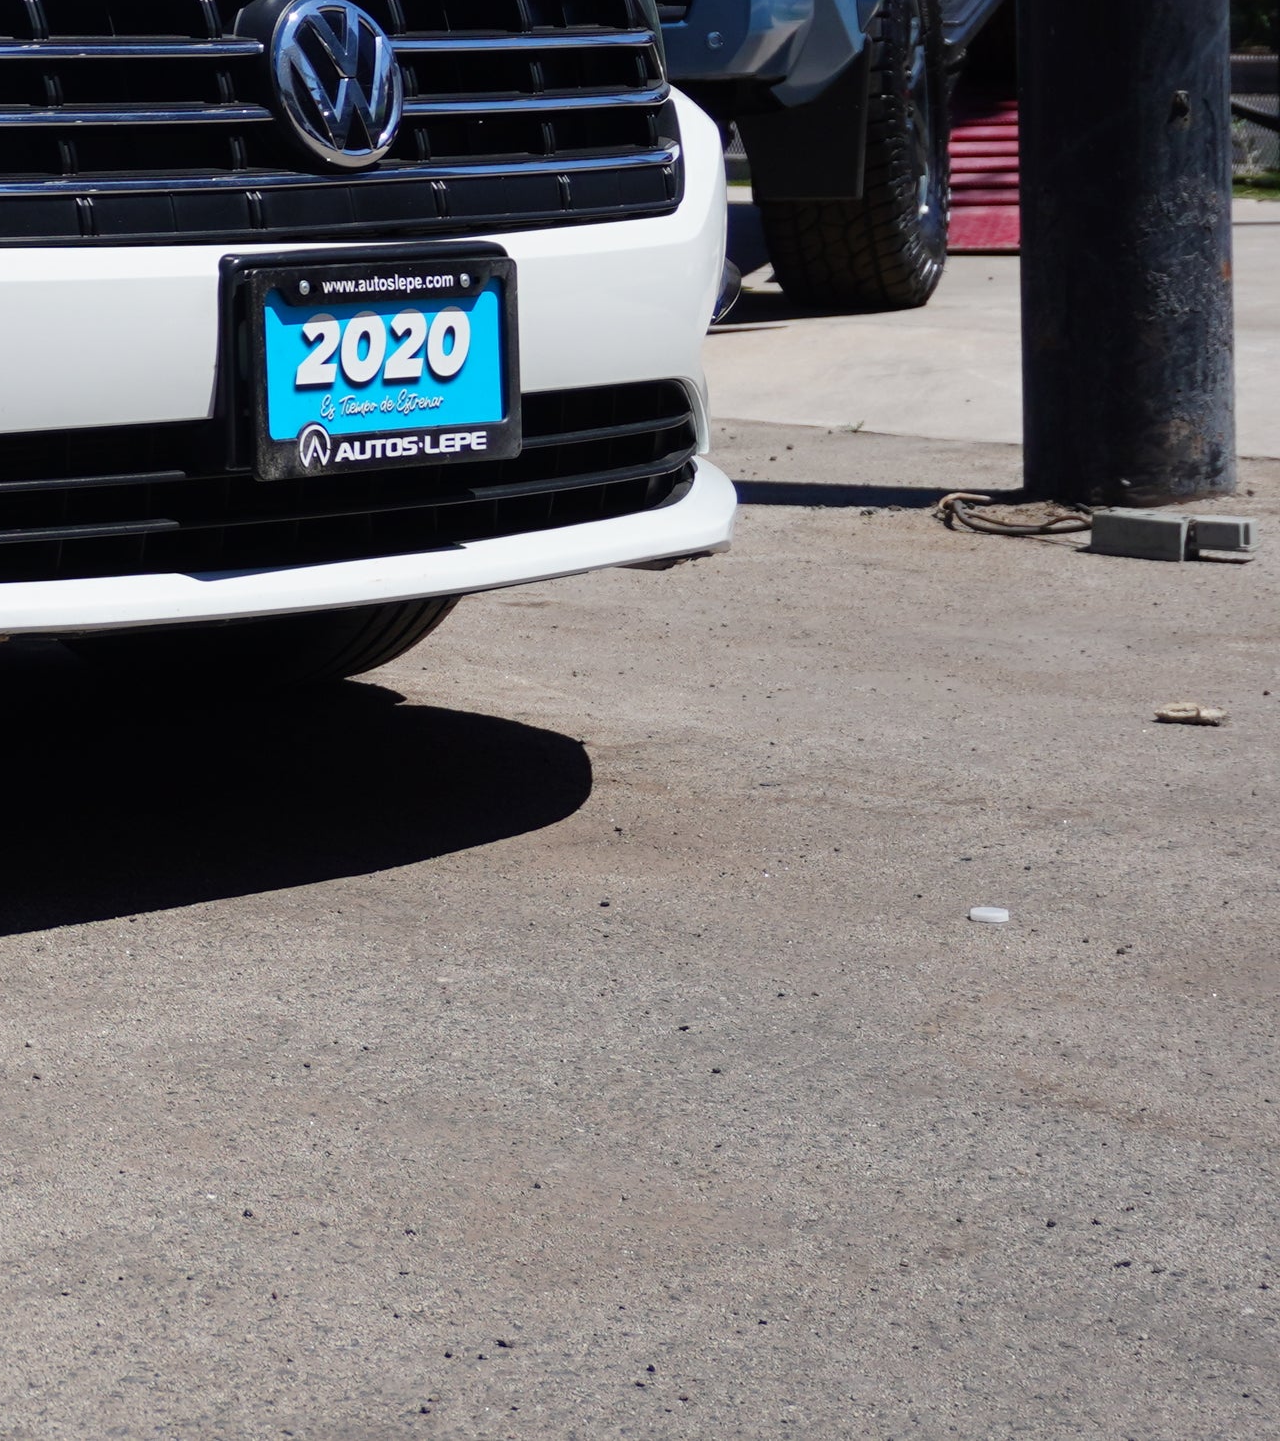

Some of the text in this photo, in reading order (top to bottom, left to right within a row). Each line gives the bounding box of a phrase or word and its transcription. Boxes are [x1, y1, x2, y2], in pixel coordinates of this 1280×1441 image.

[322, 273, 454, 294] www.autoslepe.com
[295, 306, 472, 387] 2020
[339, 394, 378, 417] Tiempo
[380, 395, 395, 413] de
[396, 388, 444, 415] Estrenar
